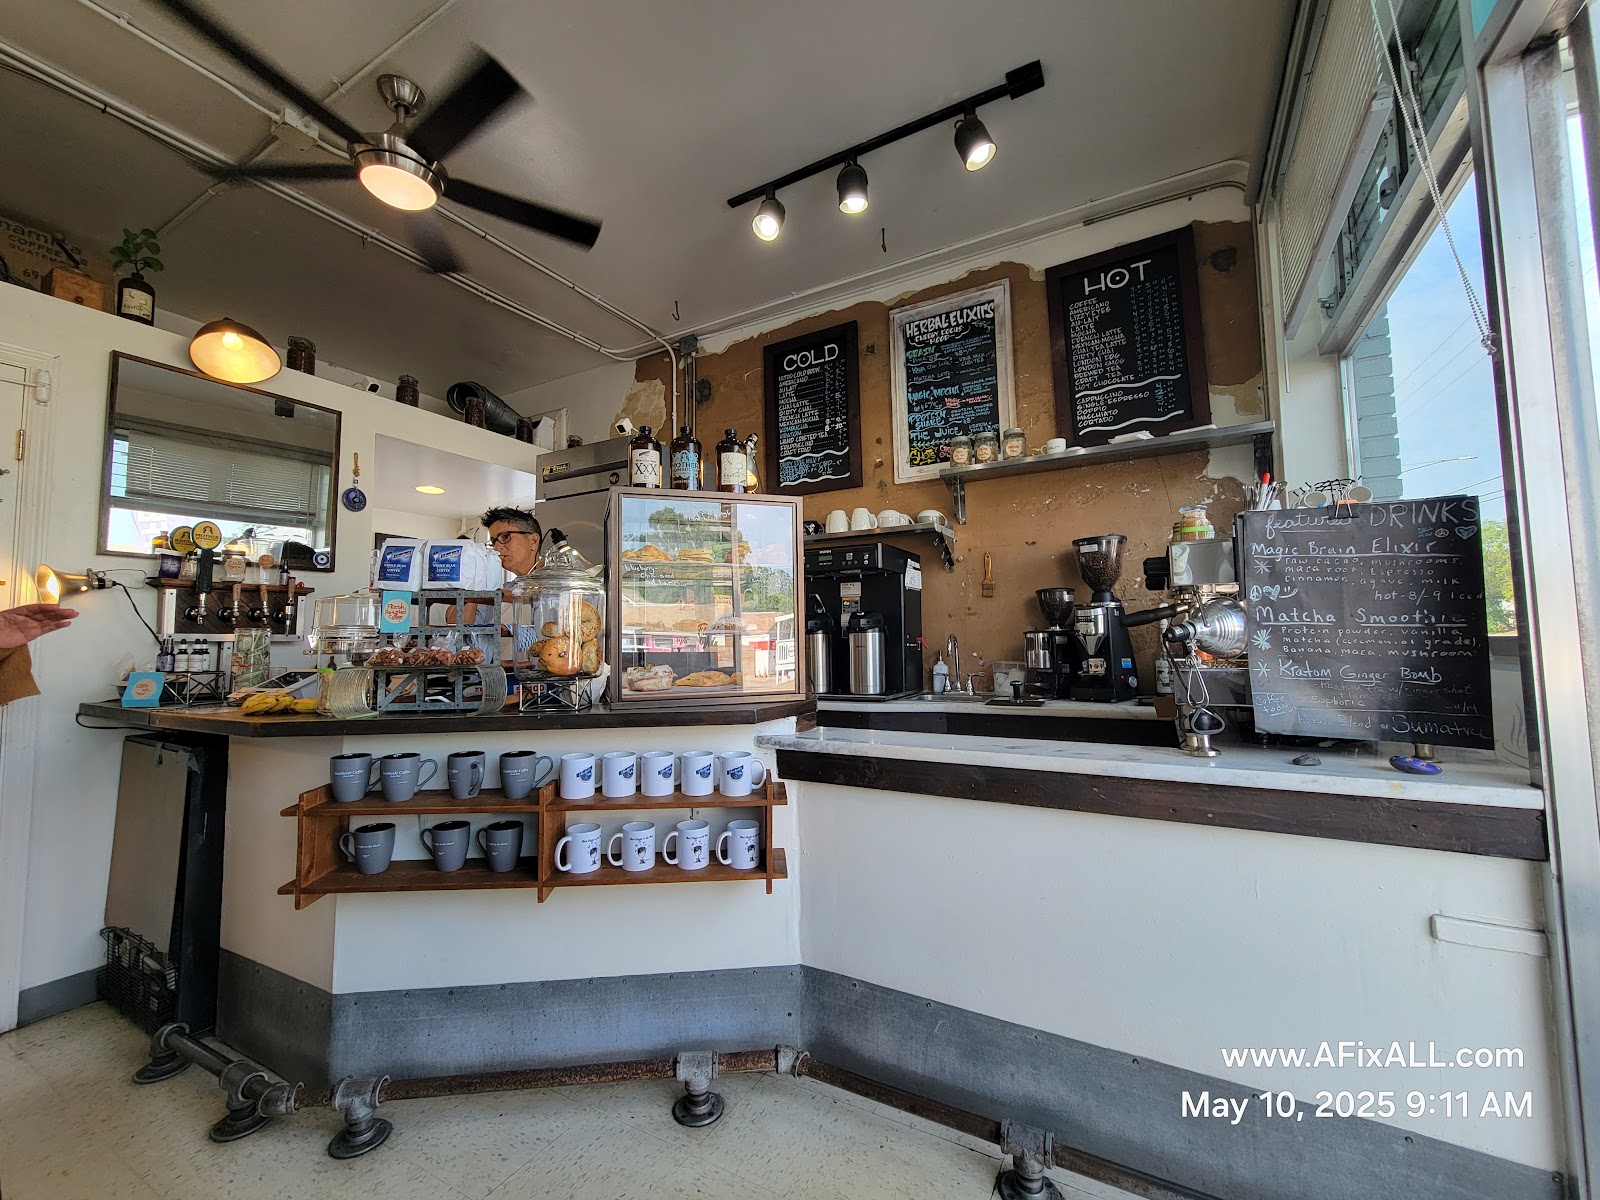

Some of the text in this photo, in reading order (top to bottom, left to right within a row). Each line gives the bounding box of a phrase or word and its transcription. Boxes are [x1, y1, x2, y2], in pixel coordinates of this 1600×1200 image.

[8, 234, 62, 258] COFFEE
[1083, 259, 1152, 296] HOT
[1069, 297, 1098, 310] COFFEE
[1069, 300, 1110, 315] AMERICANO
[941, 325, 962, 335] FOCUS
[1071, 323, 1096, 334] LATTE
[1071, 329, 1097, 339] MOCHA
[930, 335, 950, 345] MOOD
[1071, 326, 1122, 345] FRENCH LATTE
[1072, 333, 1126, 350] MEXICAN MOCHA
[1106, 338, 1128, 348] LATTE
[783, 343, 839, 372] COLD
[906, 346, 936, 360] BRAIN
[1073, 348, 1115, 361] DIRTY CHAI
[1073, 353, 1121, 369] LONDON FOG
[794, 370, 806, 379] COLD
[1073, 363, 1103, 373] LONDON
[1074, 369, 1104, 380] BREWED
[1075, 376, 1100, 386] CRAFT
[1075, 374, 1135, 392] HOT CHOCOLATE
[779, 391, 796, 399] LATTE
[933, 385, 960, 398] MOCHA
[1076, 390, 1124, 405] CAPPUCCINO
[1107, 391, 1150, 404] ESPRESSO
[779, 397, 797, 405] MOCHA
[779, 405, 812, 417] DIRTY CHAI
[801, 410, 819, 418] LATTE
[1077, 405, 1107, 416] DOPPIO
[1077, 408, 1119, 421] MACCHIATO
[779, 419, 802, 428] MEXICAN
[909, 410, 947, 425] PROTEIN
[1078, 416, 1114, 428] CORTADO
[915, 418, 945, 431] SHAKE
[910, 430, 930, 441] THE
[934, 425, 962, 438] JUICE
[910, 448, 936, 465] SHOTS
[818, 464, 834, 474] OIL
[1370, 500, 1479, 529] DRINKS
[1250, 536, 1437, 562] Magic Brain Elixir
[1421, 577, 1459, 585] milk
[1374, 590, 1397, 601] hot
[1255, 605, 1337, 623] Matcha
[1281, 626, 1330, 634] Protein
[1400, 628, 1463, 636] vanilla
[1283, 636, 1331, 644] matcha
[1388, 649, 1473, 658] mushroom
[1278, 658, 1443, 687] Kratom Ginger Bomb
[1256, 693, 1285, 706] Coffee
[1309, 696, 1366, 708] Euphoric
[1338, 714, 1371, 729] Blend
[1391, 714, 1493, 739] Sumatra
